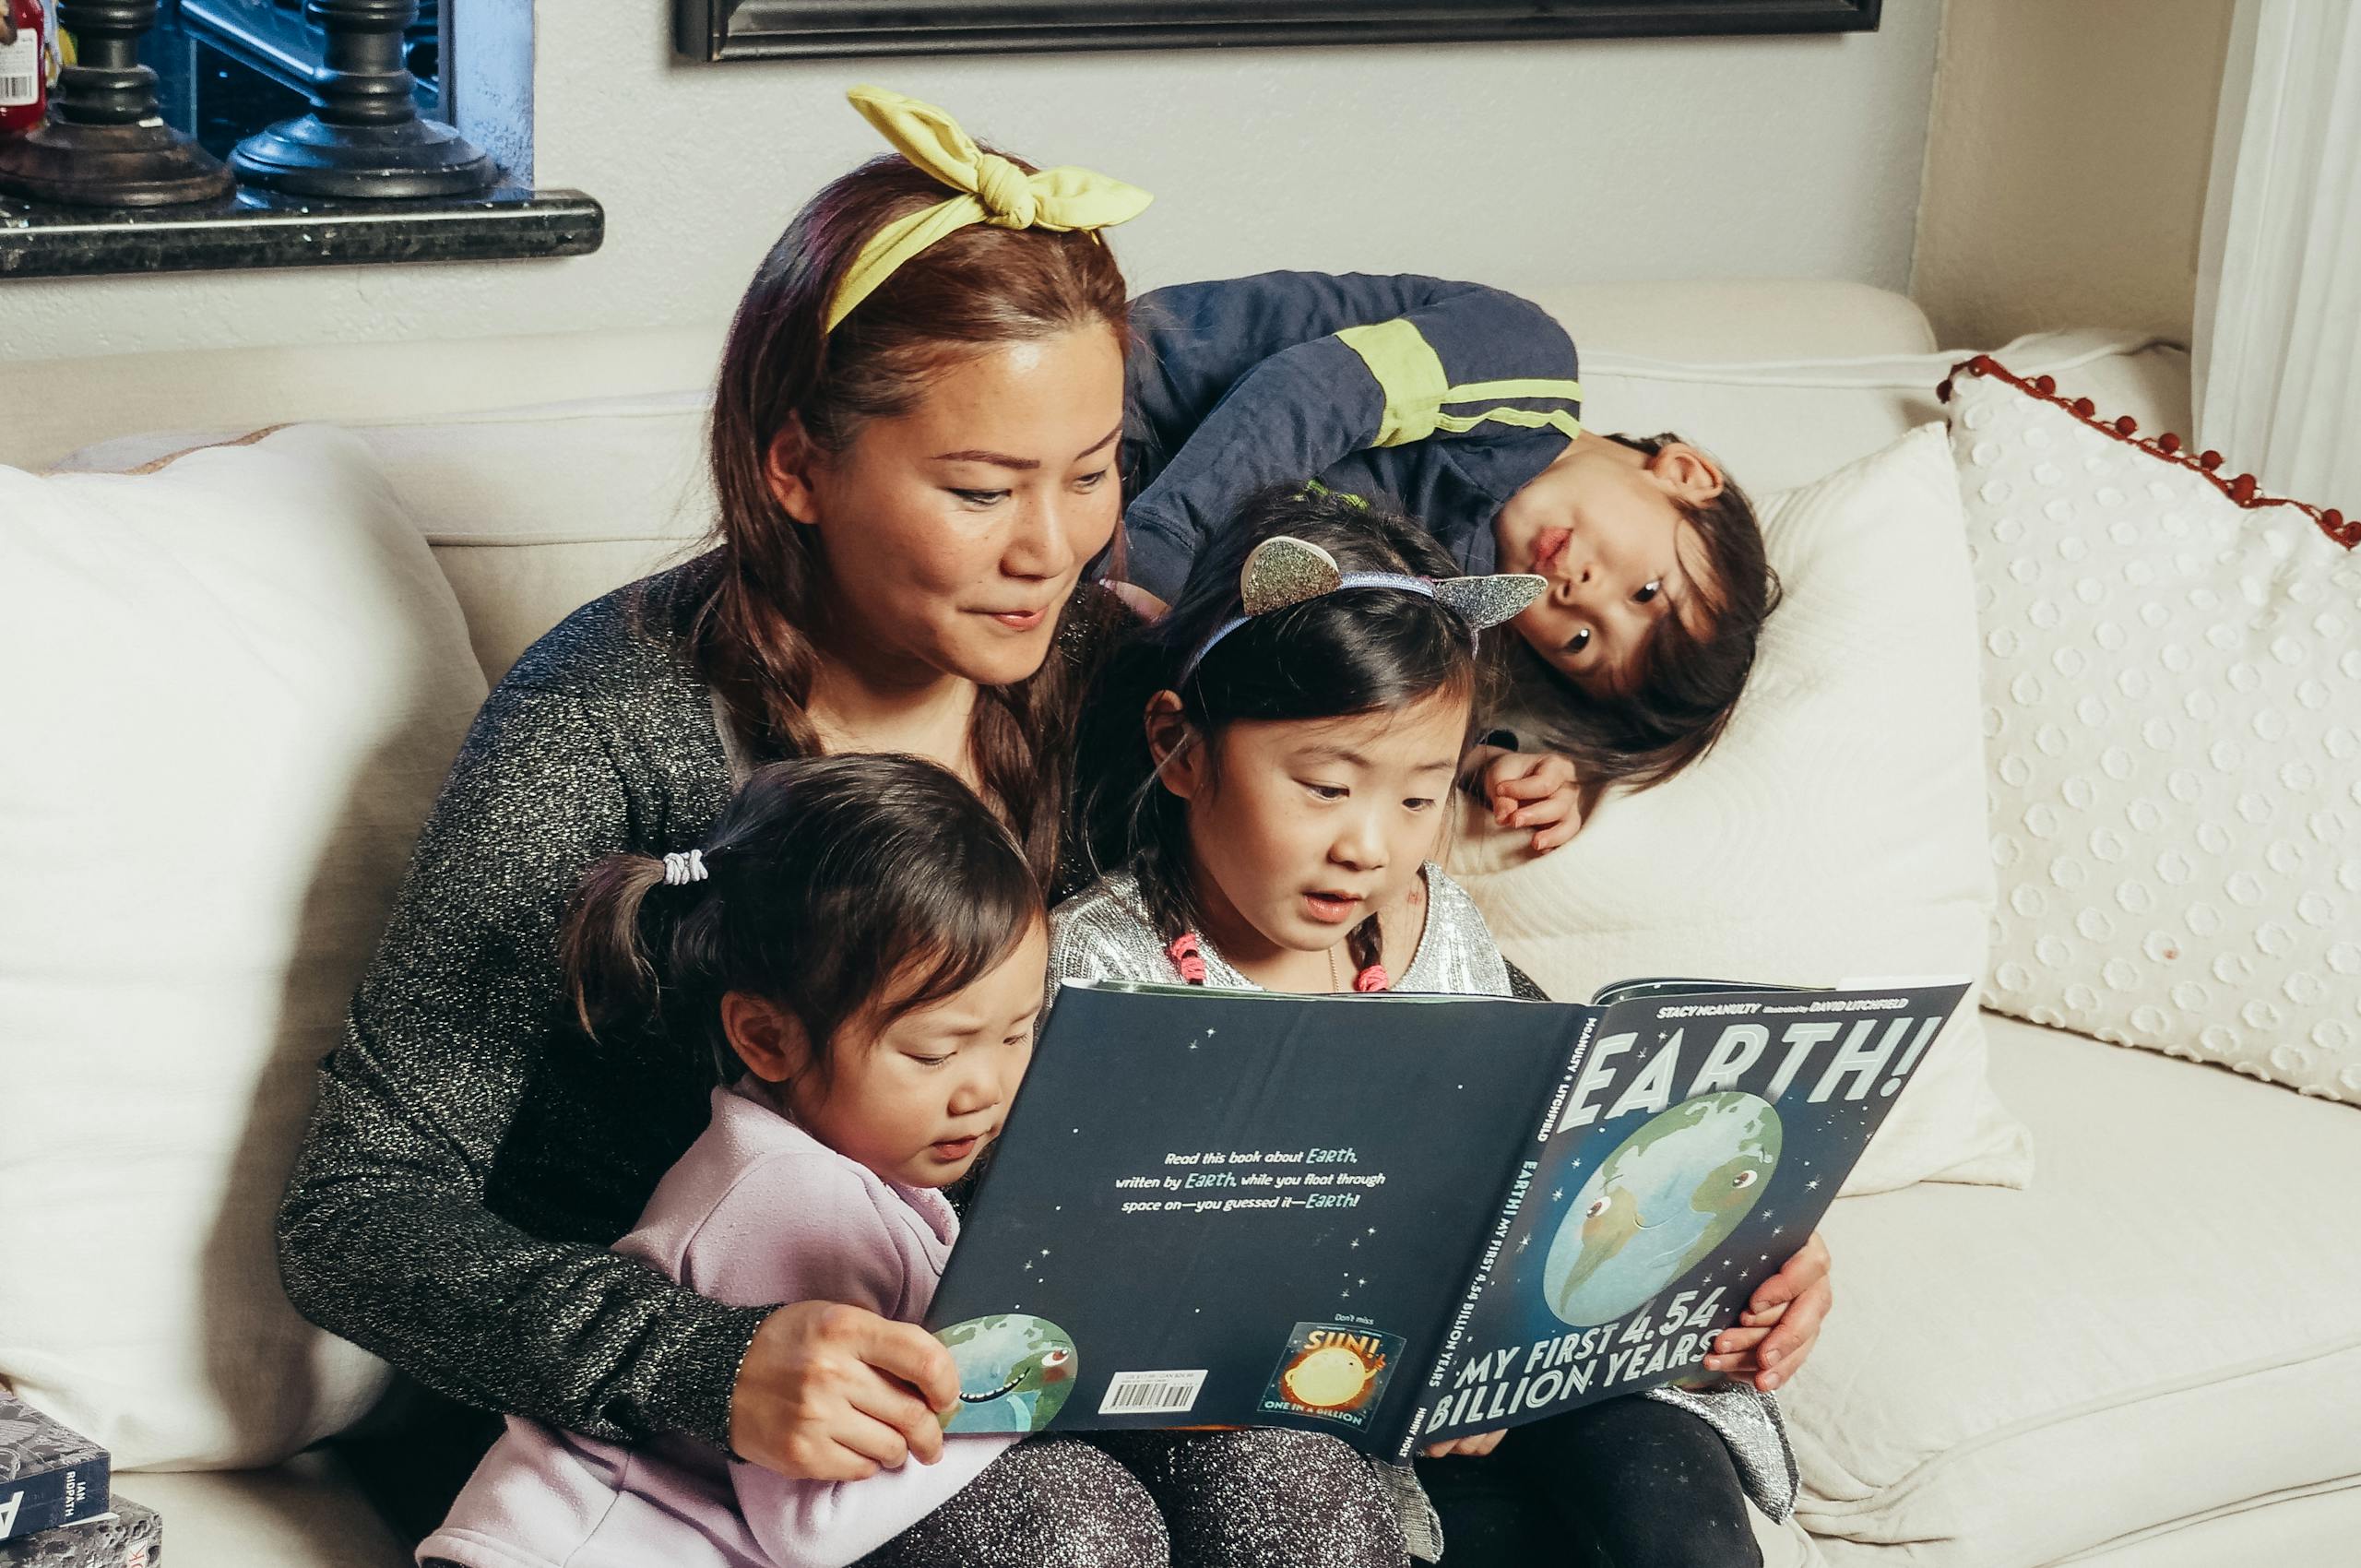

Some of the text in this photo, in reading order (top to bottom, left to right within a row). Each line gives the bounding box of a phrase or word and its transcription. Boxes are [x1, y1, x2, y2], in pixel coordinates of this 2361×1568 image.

[1656, 1004, 1698, 1019] STACY
[1809, 998, 1910, 1013] DAVID LITCHFIELD
[1556, 1016, 1943, 1134] EARTH!
[1537, 1084, 1570, 1143] LITCHFIELD
[1164, 1152, 1201, 1165] Read
[1202, 1152, 1227, 1164] this
[1228, 1150, 1263, 1164] book
[1264, 1150, 1305, 1163] about
[1115, 1176, 1161, 1188] written
[1163, 1176, 1182, 1191] by
[1240, 1173, 1274, 1186] while
[1274, 1176, 1302, 1189] you
[1303, 1172, 1335, 1186] float
[1335, 1172, 1386, 1188] through
[1121, 1201, 1162, 1214] space
[1222, 1196, 1281, 1212] guessed
[1428, 1160, 1538, 1388] EARTH! MY FIRST 4.54 BILLION YEARS
[1453, 1286, 1727, 1389] MY FIRST 4.54
[1264, 1400, 1290, 1410] ONE
[1290, 1402, 1305, 1412] IN
[1425, 1359, 1597, 1435] BILLION
[1398, 1407, 1428, 1458] HENRY HOLT
[65, 1470, 77, 1517] RIDPATH
[76, 1481, 87, 1502] IAN
